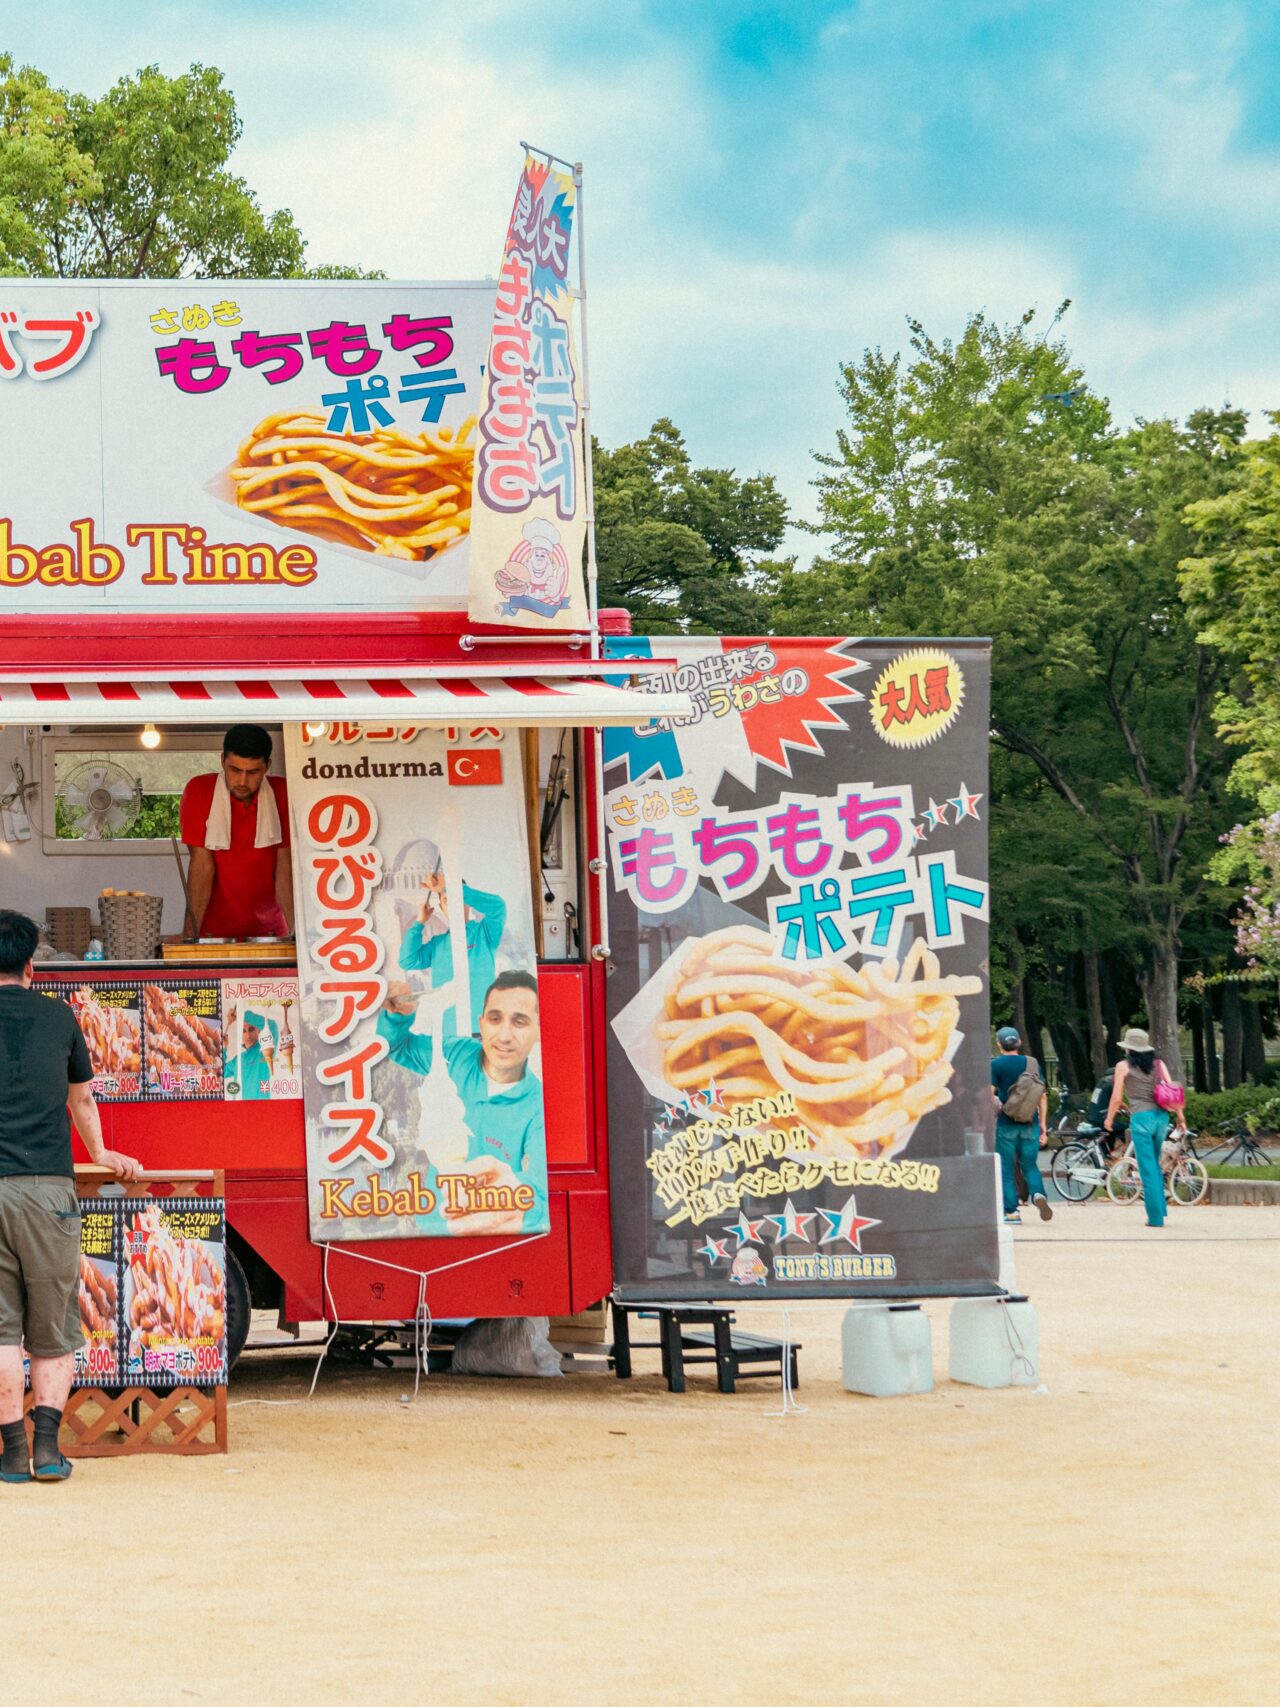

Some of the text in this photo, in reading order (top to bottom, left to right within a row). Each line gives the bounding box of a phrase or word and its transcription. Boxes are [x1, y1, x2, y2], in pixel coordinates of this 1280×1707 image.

[150, 300, 243, 335] さぬき
[155, 314, 454, 394] もちもち
[322, 366, 484, 433] ポテ
[126, 523, 318, 586] Time
[880, 665, 952, 731] 大人気
[301, 756, 444, 780] dondurma
[611, 786, 700, 826] さぬき
[620, 792, 904, 904] もちもち
[776, 862, 985, 960] ポテト
[225, 983, 298, 998] トルコアイス
[306, 792, 391, 1168] のびるアイス
[320, 1172, 535, 1219] Kebab Time
[775, 1253, 896, 1280] TONY'S BURGER
